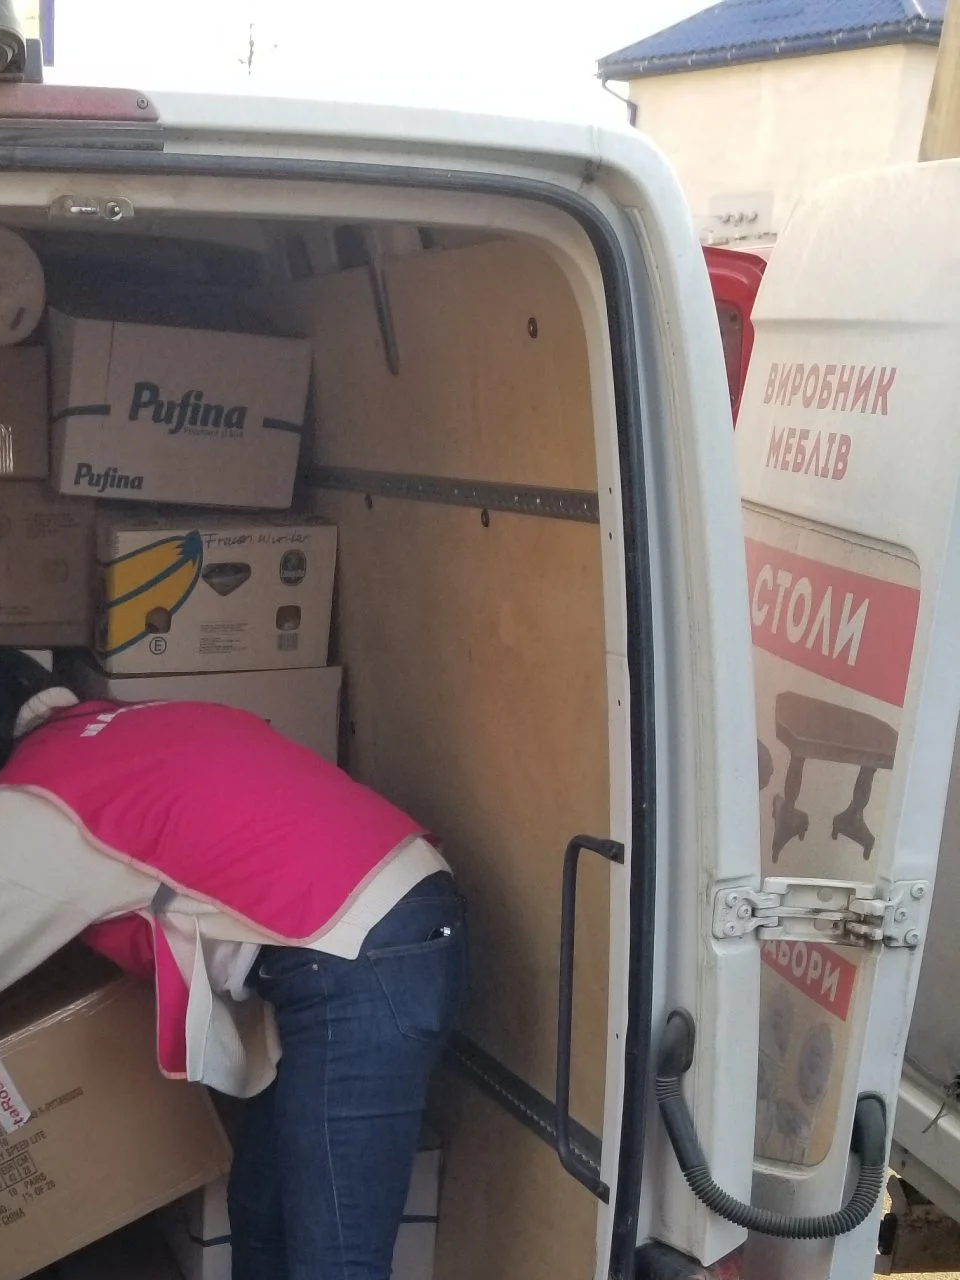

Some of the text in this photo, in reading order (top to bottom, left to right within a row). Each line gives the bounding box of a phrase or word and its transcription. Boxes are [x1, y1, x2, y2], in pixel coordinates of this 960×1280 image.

[128, 381, 248, 434] Pufina
[763, 362, 897, 416] ВИРОБНИК
[73, 463, 144, 492] Pufina
[765, 425, 852, 480] МЕБЛІВ
[752, 563, 870, 666] СТОЛИ
[764, 940, 840, 1002] АБОРИ
